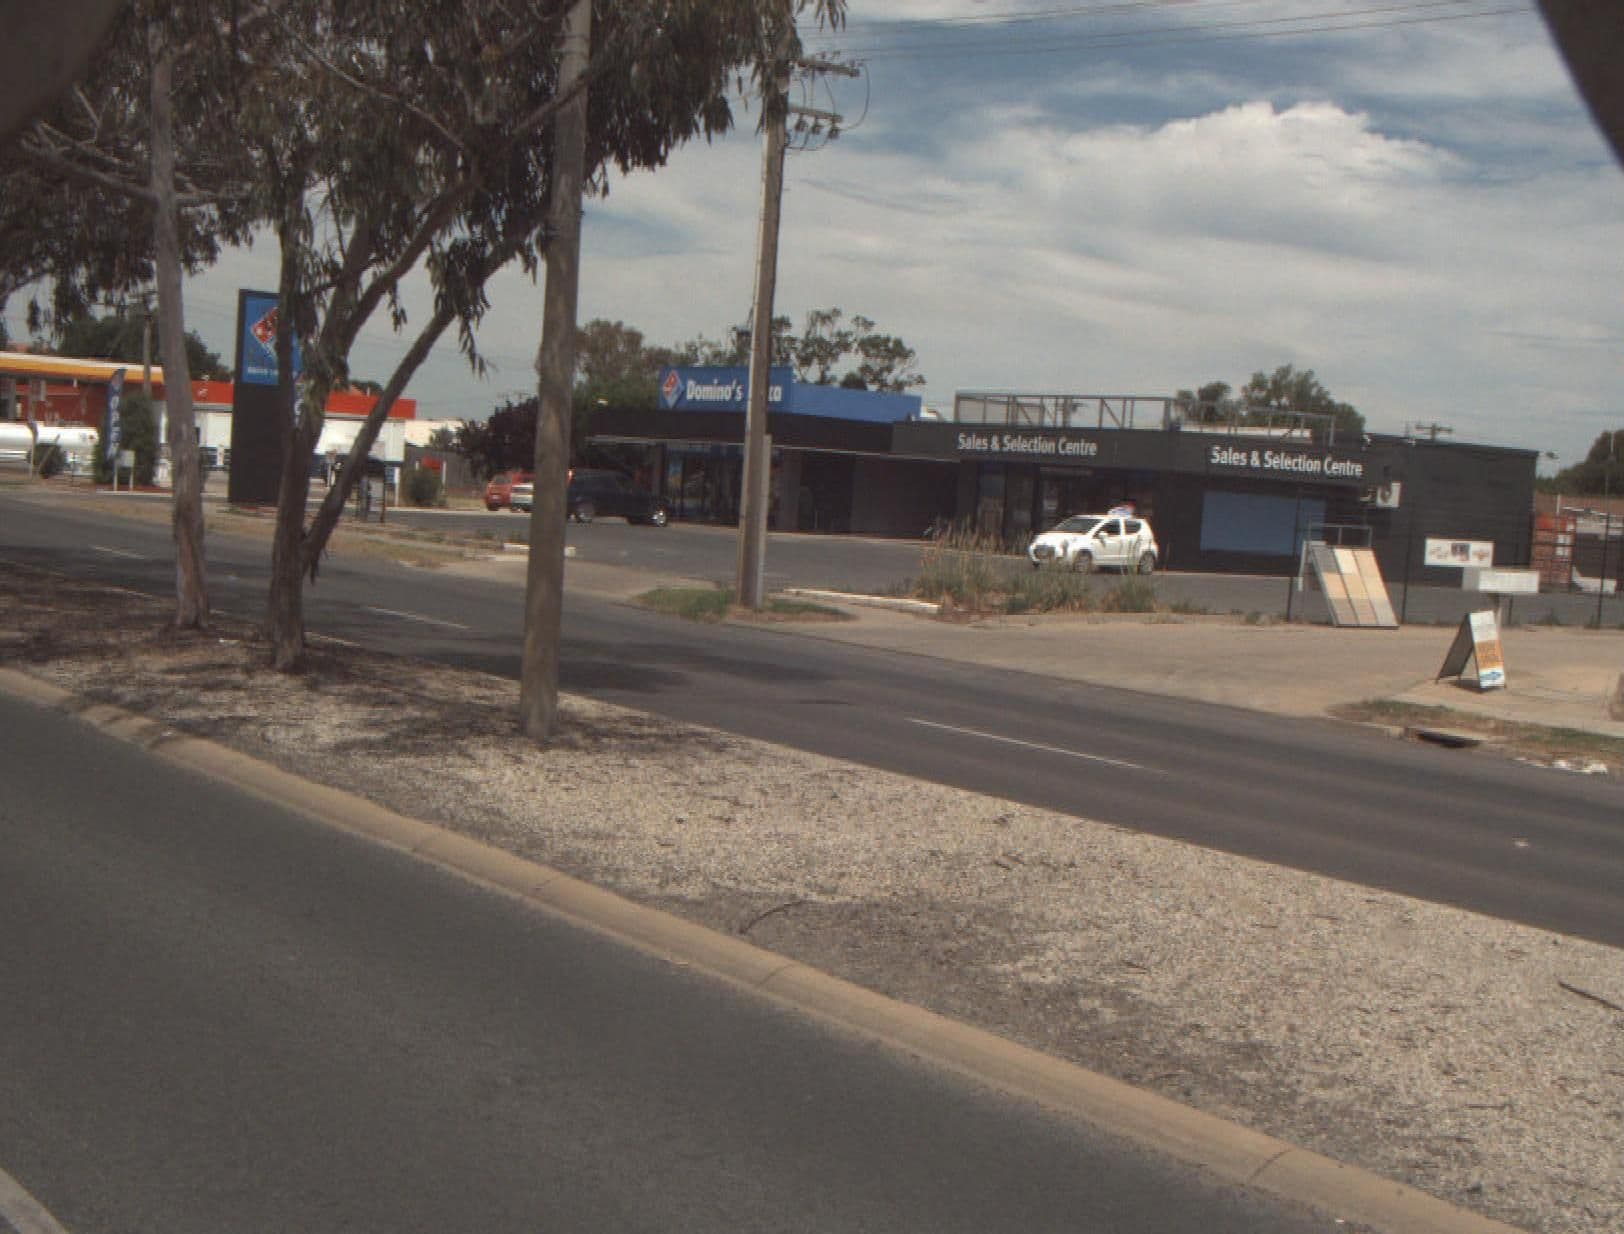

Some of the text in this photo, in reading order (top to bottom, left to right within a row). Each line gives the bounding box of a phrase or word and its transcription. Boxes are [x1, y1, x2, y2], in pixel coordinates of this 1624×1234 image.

[686, 378, 744, 402] Domino's
[958, 432, 1097, 456] Sales & Selection Centre
[1210, 446, 1363, 477] Sales & Selection Centre
